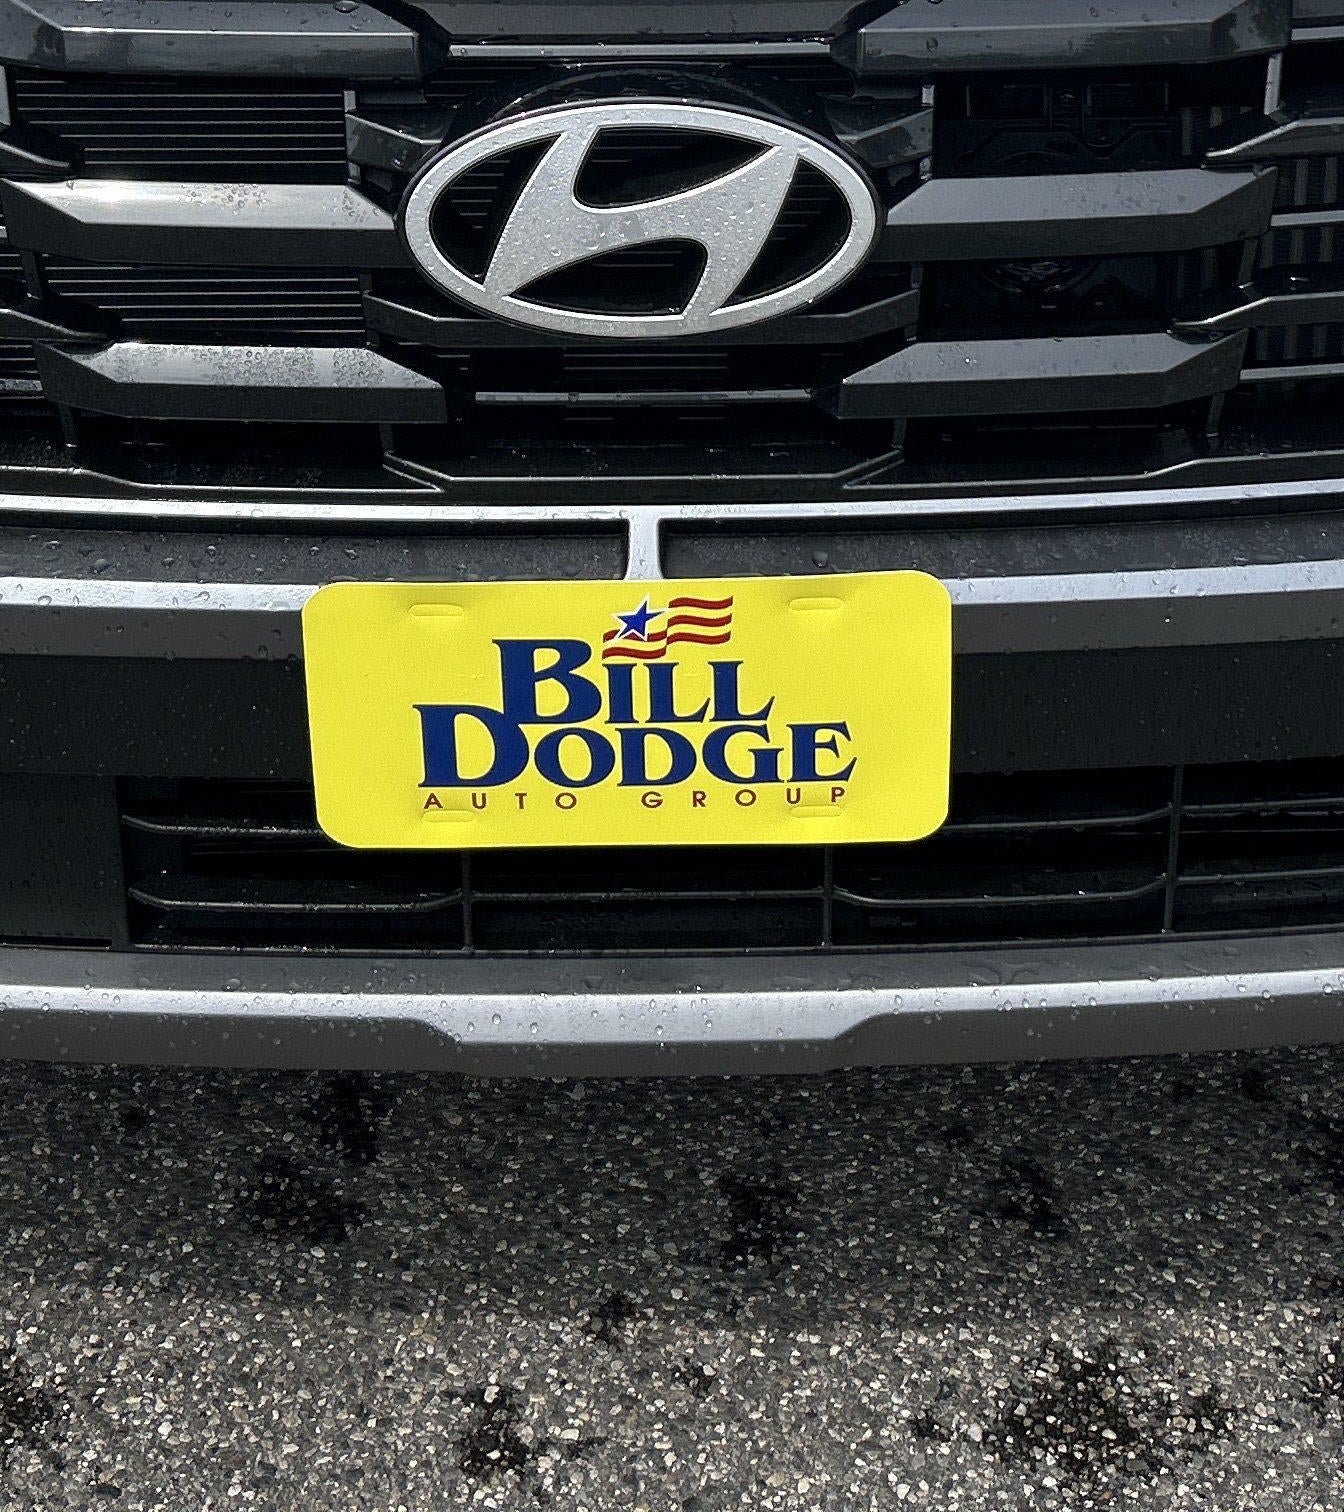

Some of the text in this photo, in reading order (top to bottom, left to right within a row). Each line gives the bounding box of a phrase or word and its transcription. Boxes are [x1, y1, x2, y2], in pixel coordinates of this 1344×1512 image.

[492, 638, 776, 724] BILL
[413, 704, 857, 788] DODGE
[424, 786, 849, 810] AUTO GROUP
